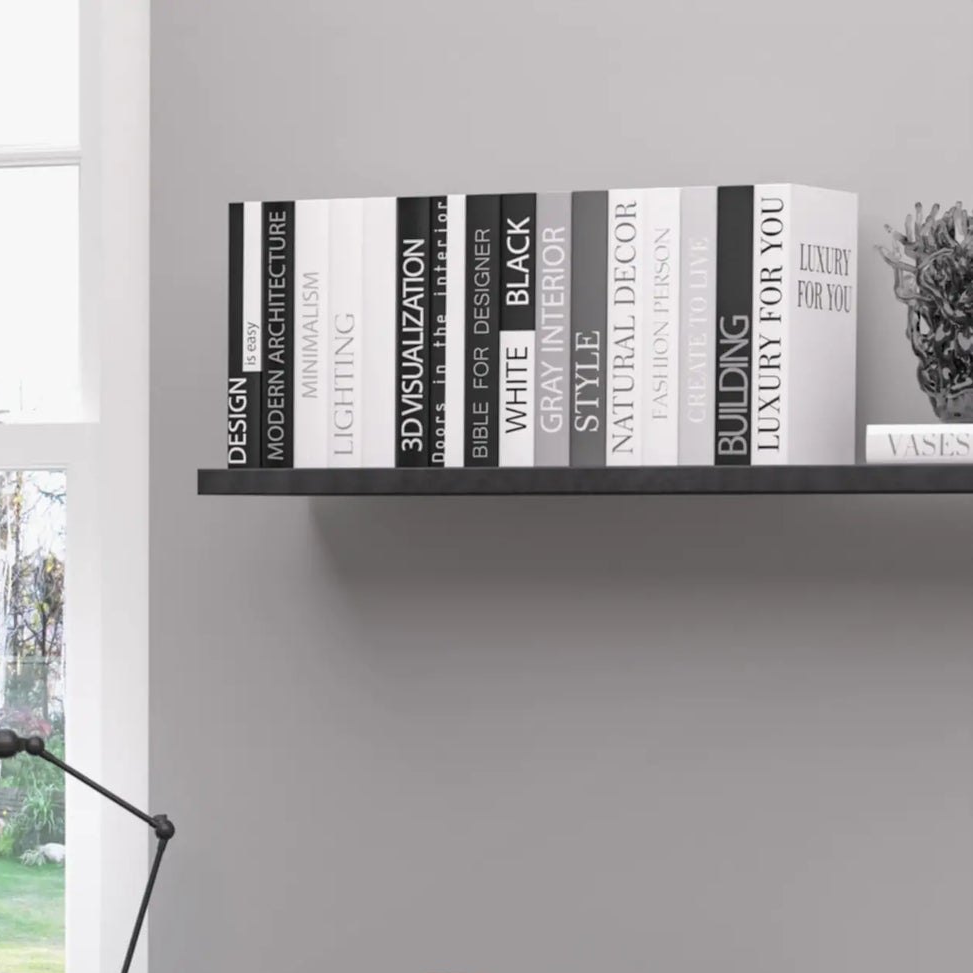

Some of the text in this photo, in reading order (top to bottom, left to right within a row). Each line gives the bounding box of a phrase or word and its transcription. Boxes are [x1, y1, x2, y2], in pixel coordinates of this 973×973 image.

[244, 321, 261, 366] is easy
[267, 210, 287, 460] MODERN ARCHITECTURE
[301, 271, 320, 399] MINIMALISM
[431, 201, 448, 464] Doors in the interior
[472, 227, 491, 459] BIBLE FOR DESIGNER
[505, 216, 531, 434] WHITE BLACK
[540, 226, 566, 434] GRAY INTERIOR
[611, 200, 638, 455] NATURAL DECOR
[652, 226, 671, 421] FASHION PERSON
[687, 236, 709, 424] CREATE TO LIVE
[757, 197, 785, 452] LUXURY FOR YOU
[797, 280, 852, 313] FOR YOU
[799, 243, 852, 278] LUXURY
[228, 377, 248, 465] DESIGN
[333, 312, 355, 456] LIGHTING
[574, 329, 601, 432] STYLE
[717, 314, 749, 456] BUILDING
[888, 432, 970, 457] VASES
